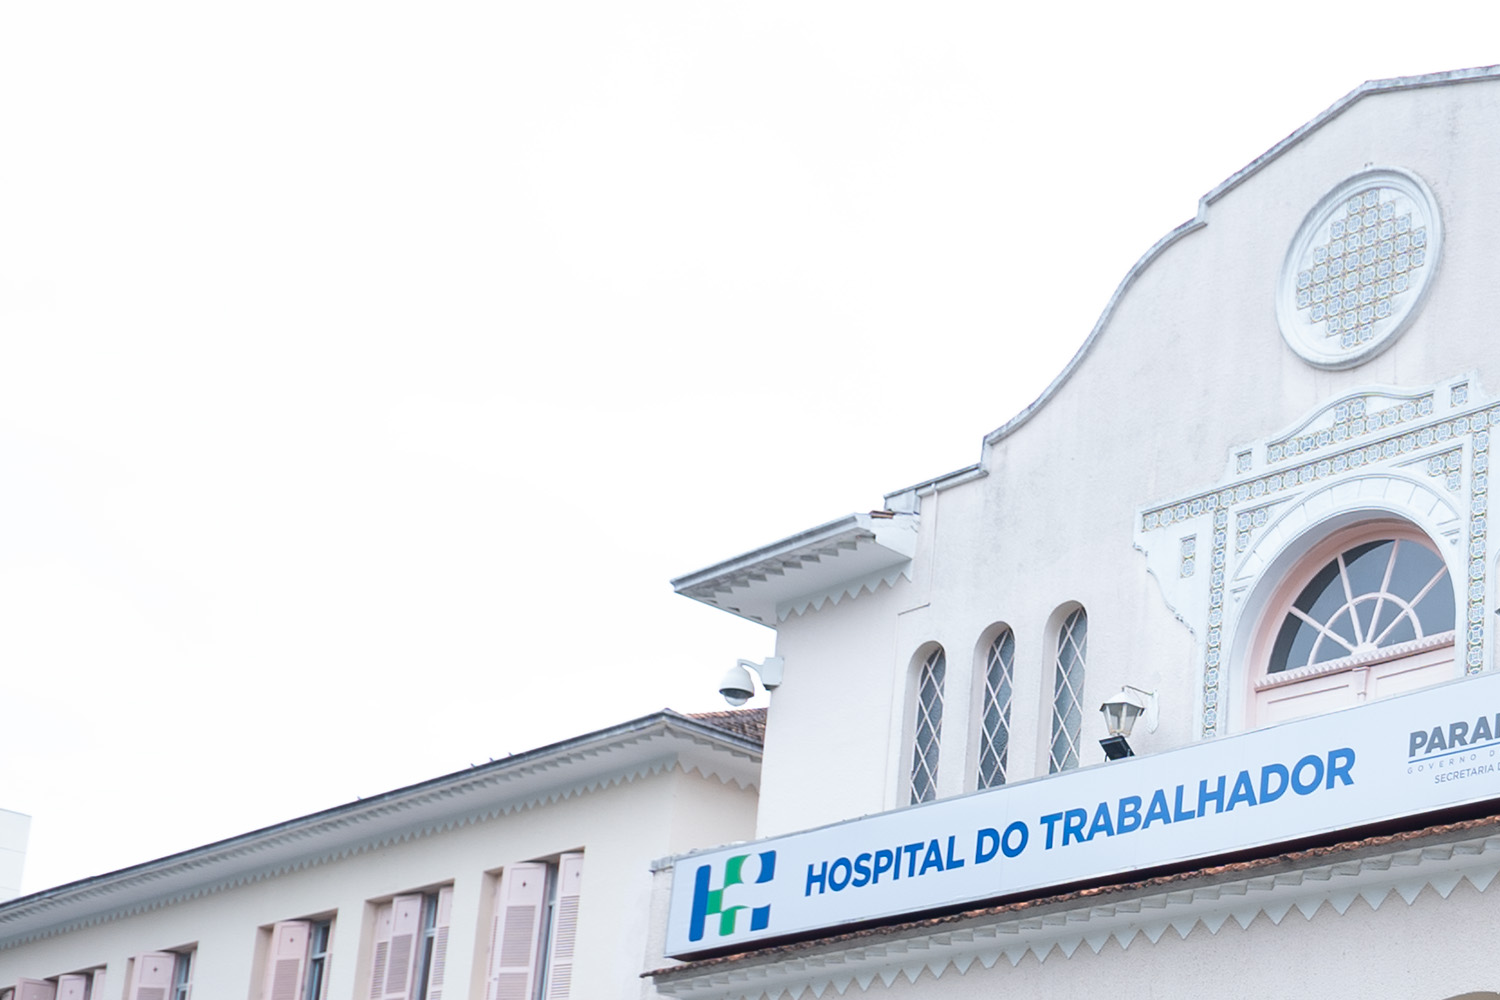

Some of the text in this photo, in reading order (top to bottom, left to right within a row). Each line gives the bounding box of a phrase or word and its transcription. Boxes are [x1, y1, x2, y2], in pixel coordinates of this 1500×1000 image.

[1407, 754, 1476, 774] GOVERNO
[1434, 764, 1495, 784] SECRETARIA
[804, 747, 1356, 897] HOSPITAL DO TRABALHADOR
